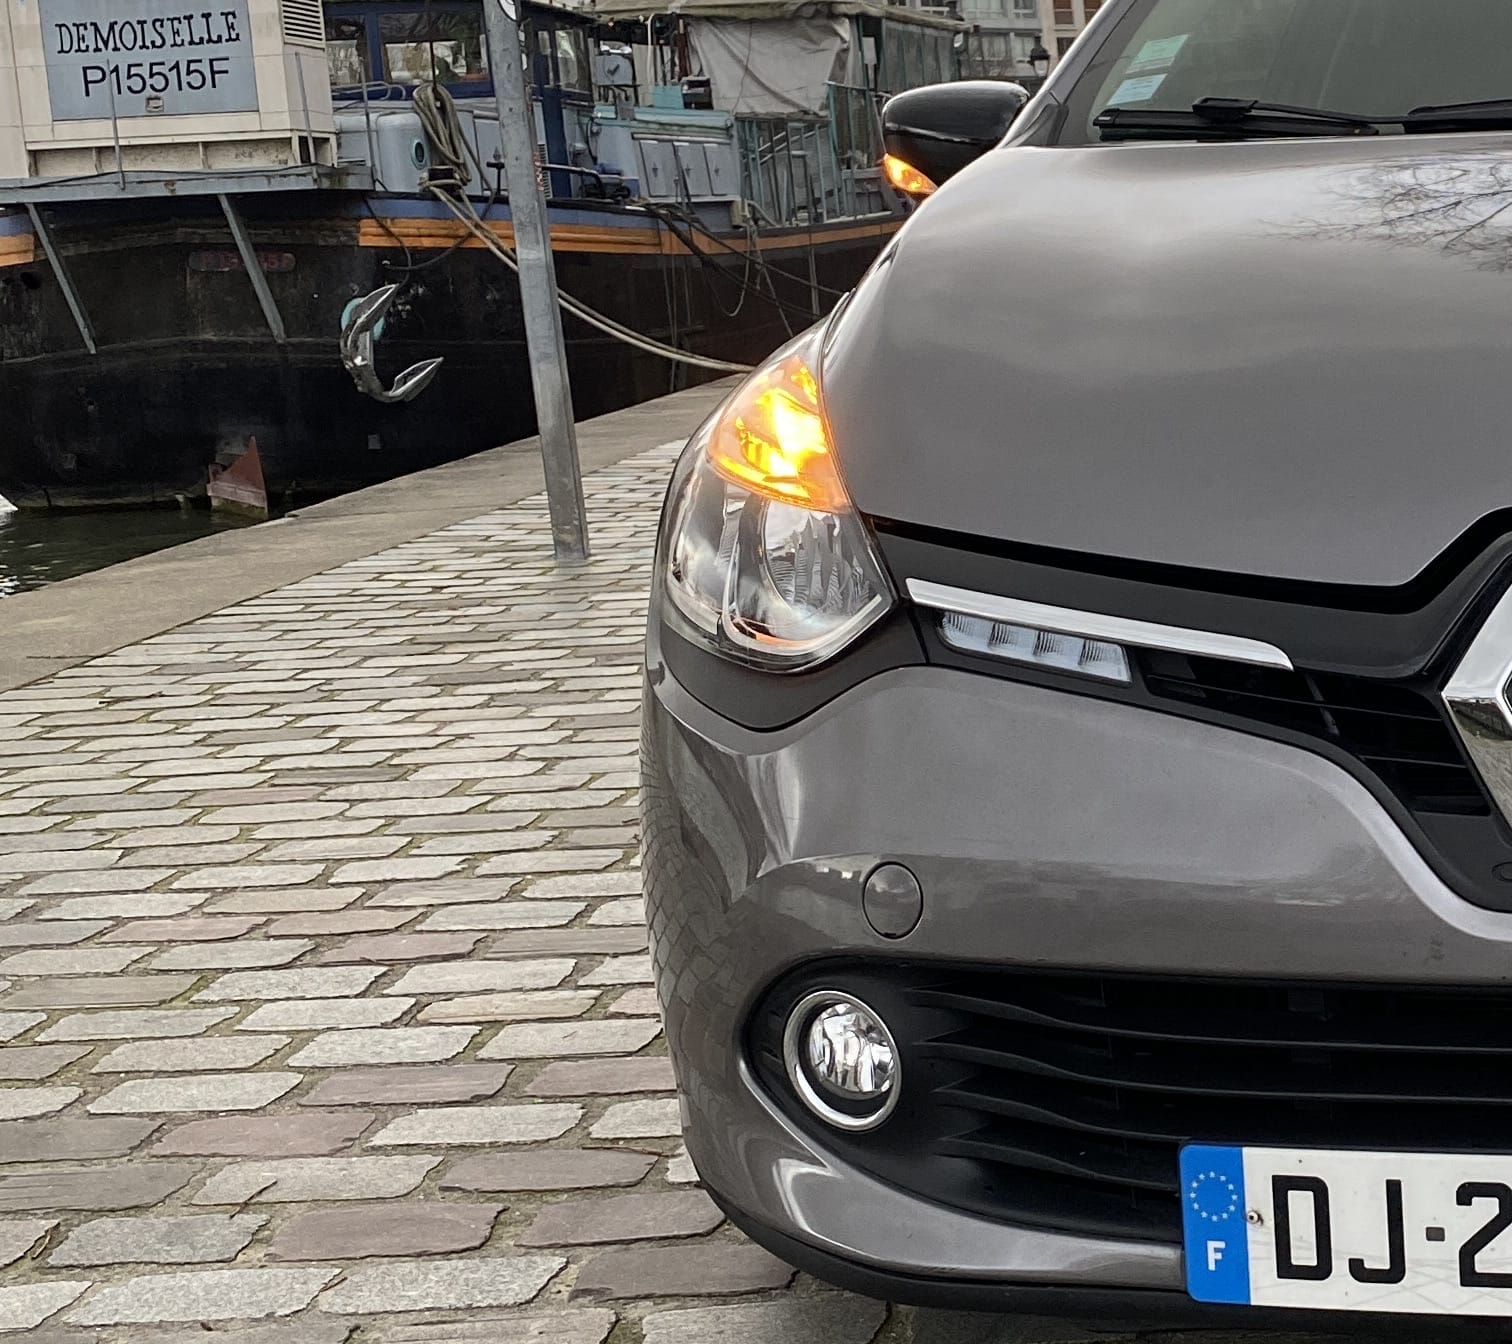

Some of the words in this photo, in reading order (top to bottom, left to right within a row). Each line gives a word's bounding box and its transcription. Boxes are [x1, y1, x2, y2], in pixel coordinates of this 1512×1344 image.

[55, 11, 241, 55] DEMOISELLE
[82, 57, 230, 97] P15515F
[1208, 1241, 1226, 1271] F
